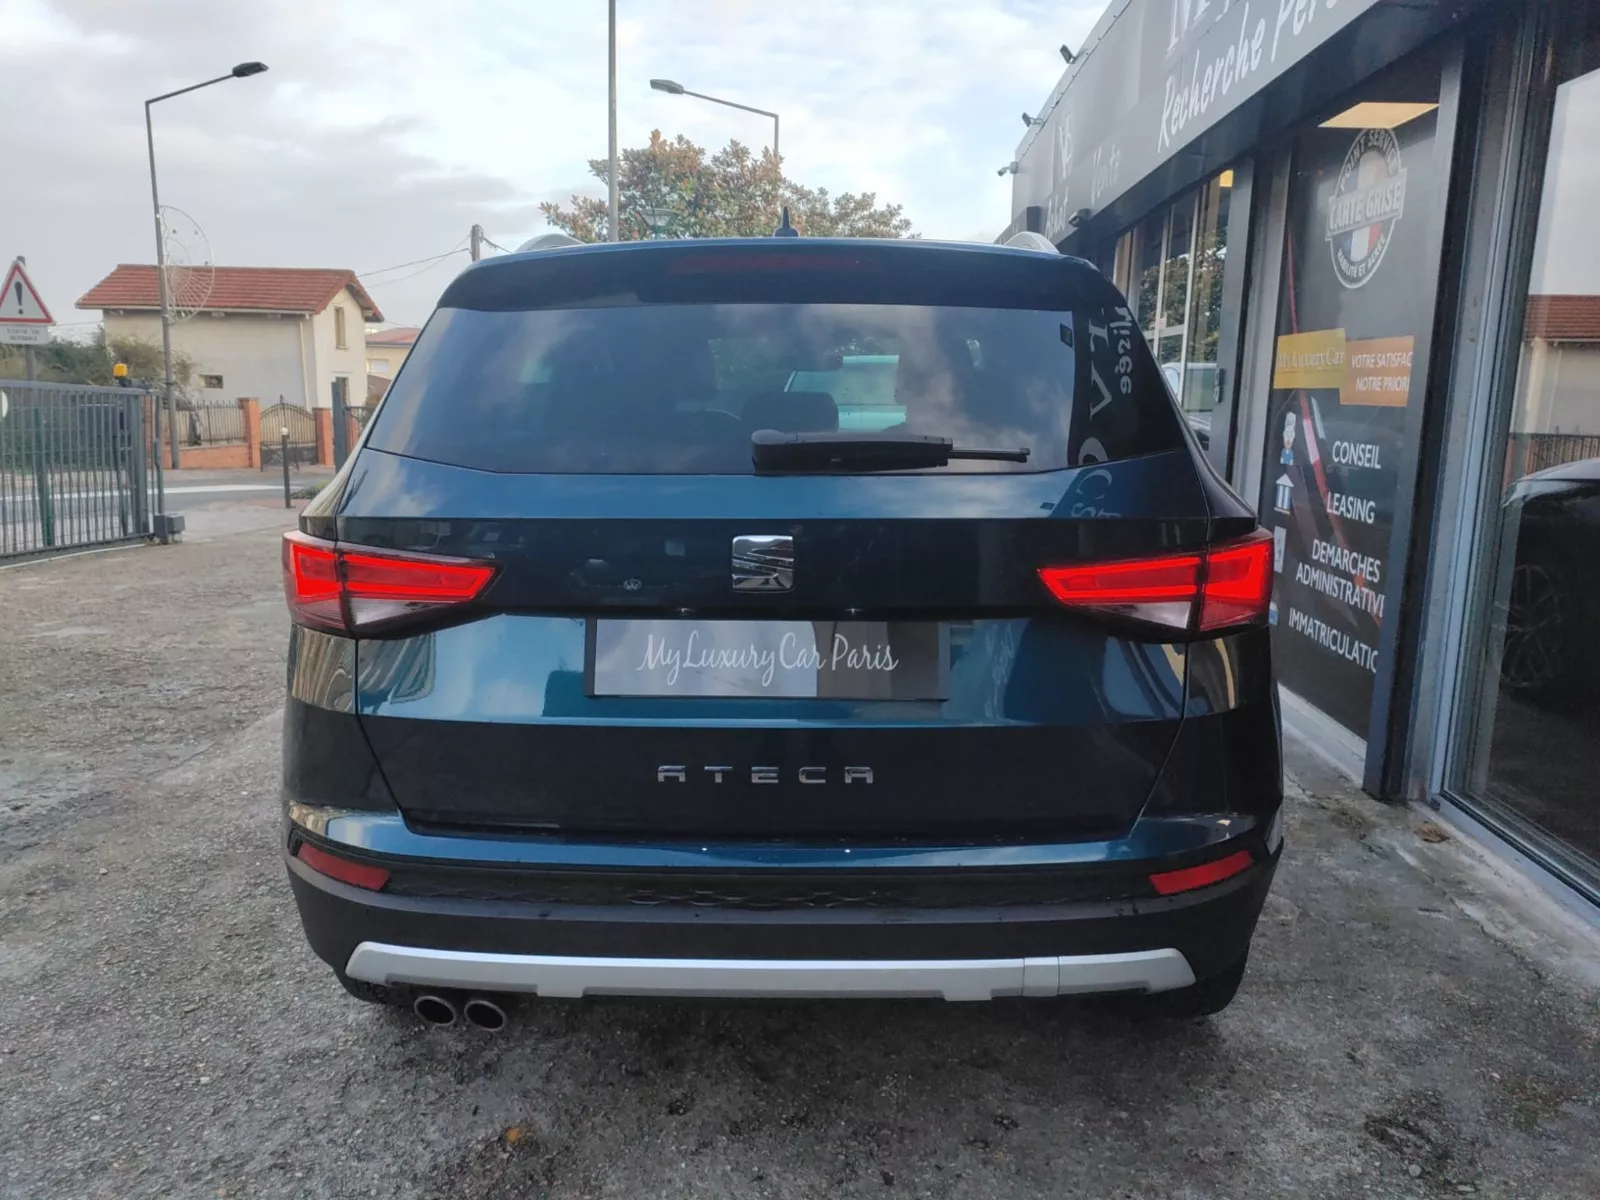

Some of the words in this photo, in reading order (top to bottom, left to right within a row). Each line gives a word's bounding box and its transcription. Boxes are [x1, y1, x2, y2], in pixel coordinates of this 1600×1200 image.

[1157, 1, 1266, 153] Recherche
[1330, 193, 1364, 231] CARTE
[1366, 180, 1402, 218] GRISE
[1352, 353, 1376, 369] VOTRE
[1356, 376, 1381, 391] NOTRE
[1332, 440, 1381, 470] CONSEIL
[1326, 491, 1376, 525] LEASING
[1312, 539, 1382, 584] DEMARCHES
[832, 632, 899, 671] Paris
[657, 765, 874, 784] ATECA
